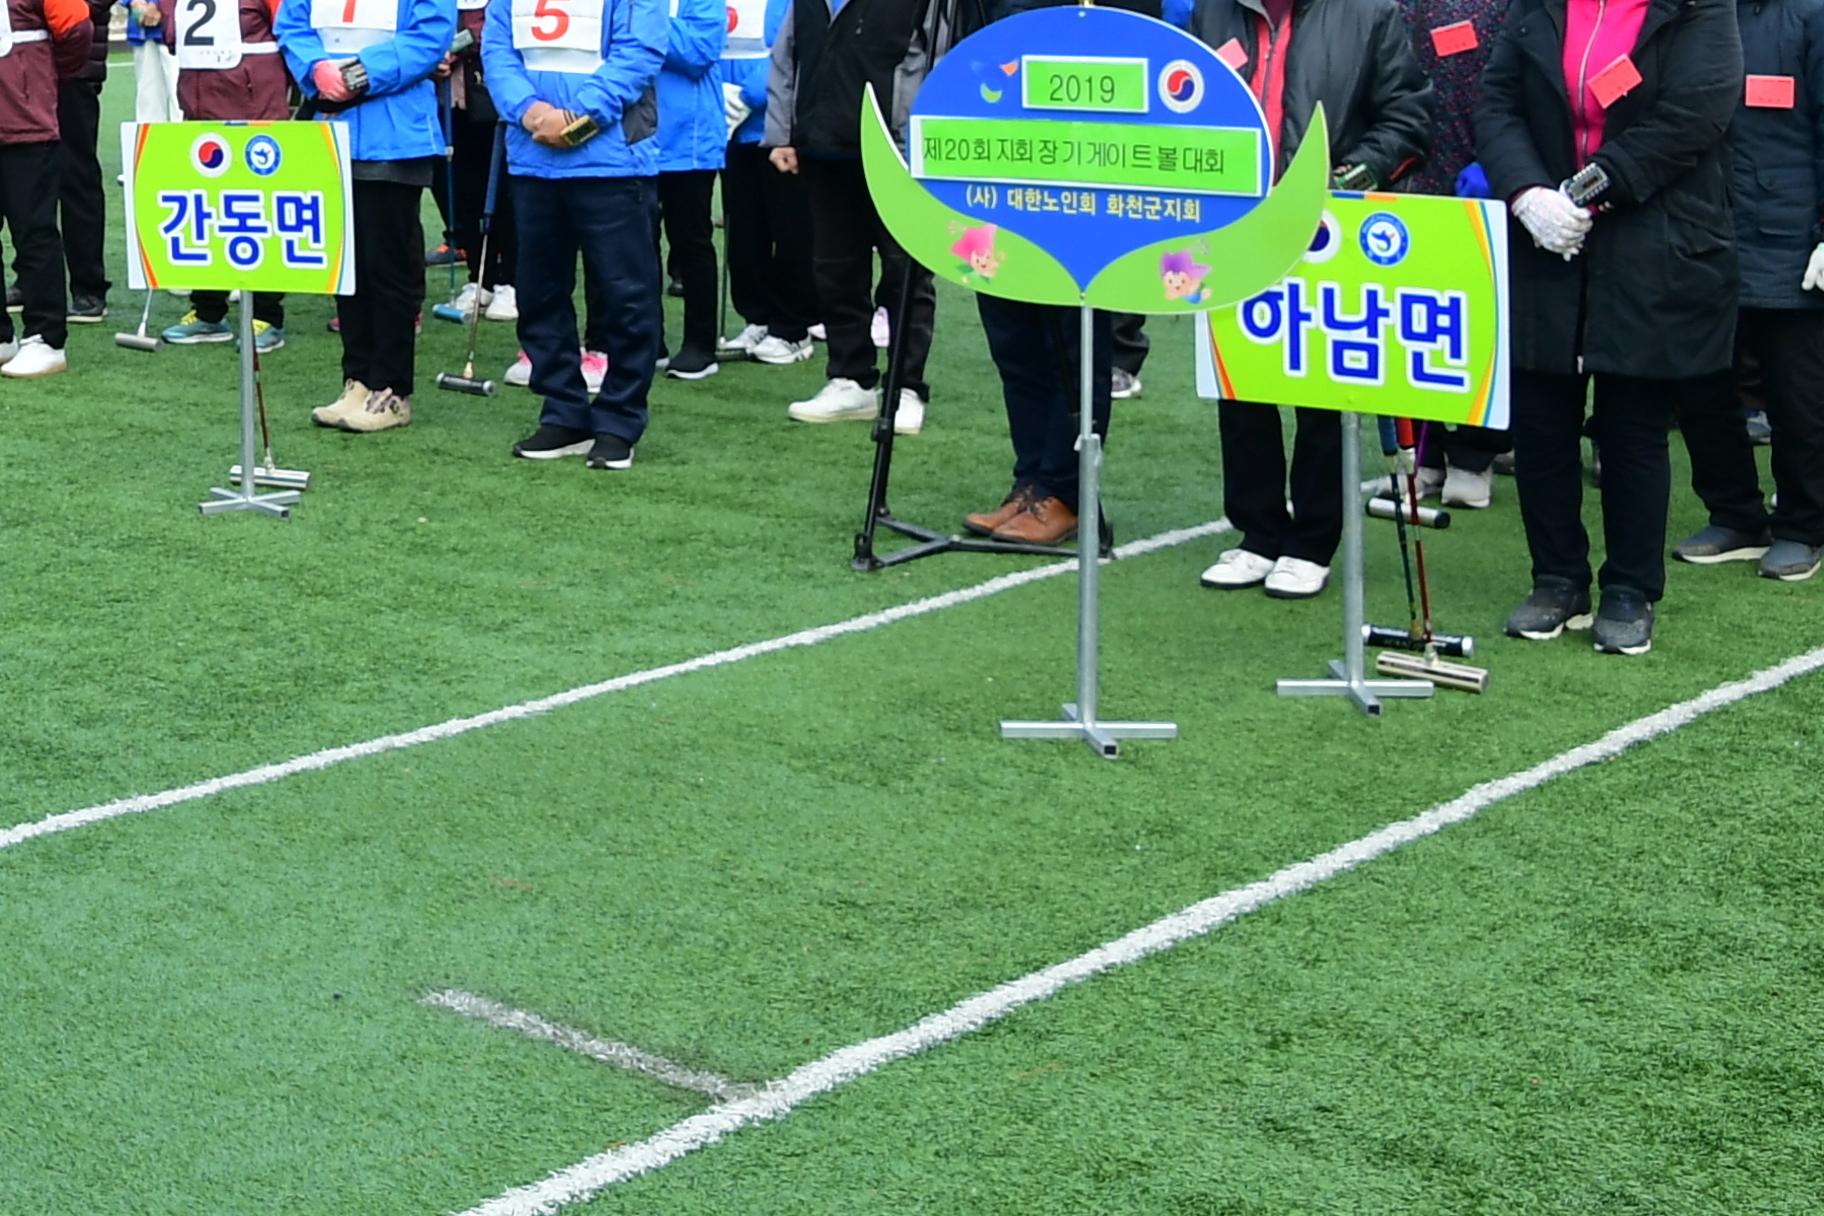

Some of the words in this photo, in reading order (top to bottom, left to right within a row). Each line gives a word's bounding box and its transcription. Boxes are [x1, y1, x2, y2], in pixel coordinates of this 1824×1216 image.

[1049, 74, 1115, 103] 2019
[162, 194, 324, 265] 간동면
[966, 185, 998, 208] (사)
[1007, 187, 1096, 216] 대한노인회
[1106, 193, 1200, 223] 화천군지회
[1242, 283, 1465, 386] 하남면
